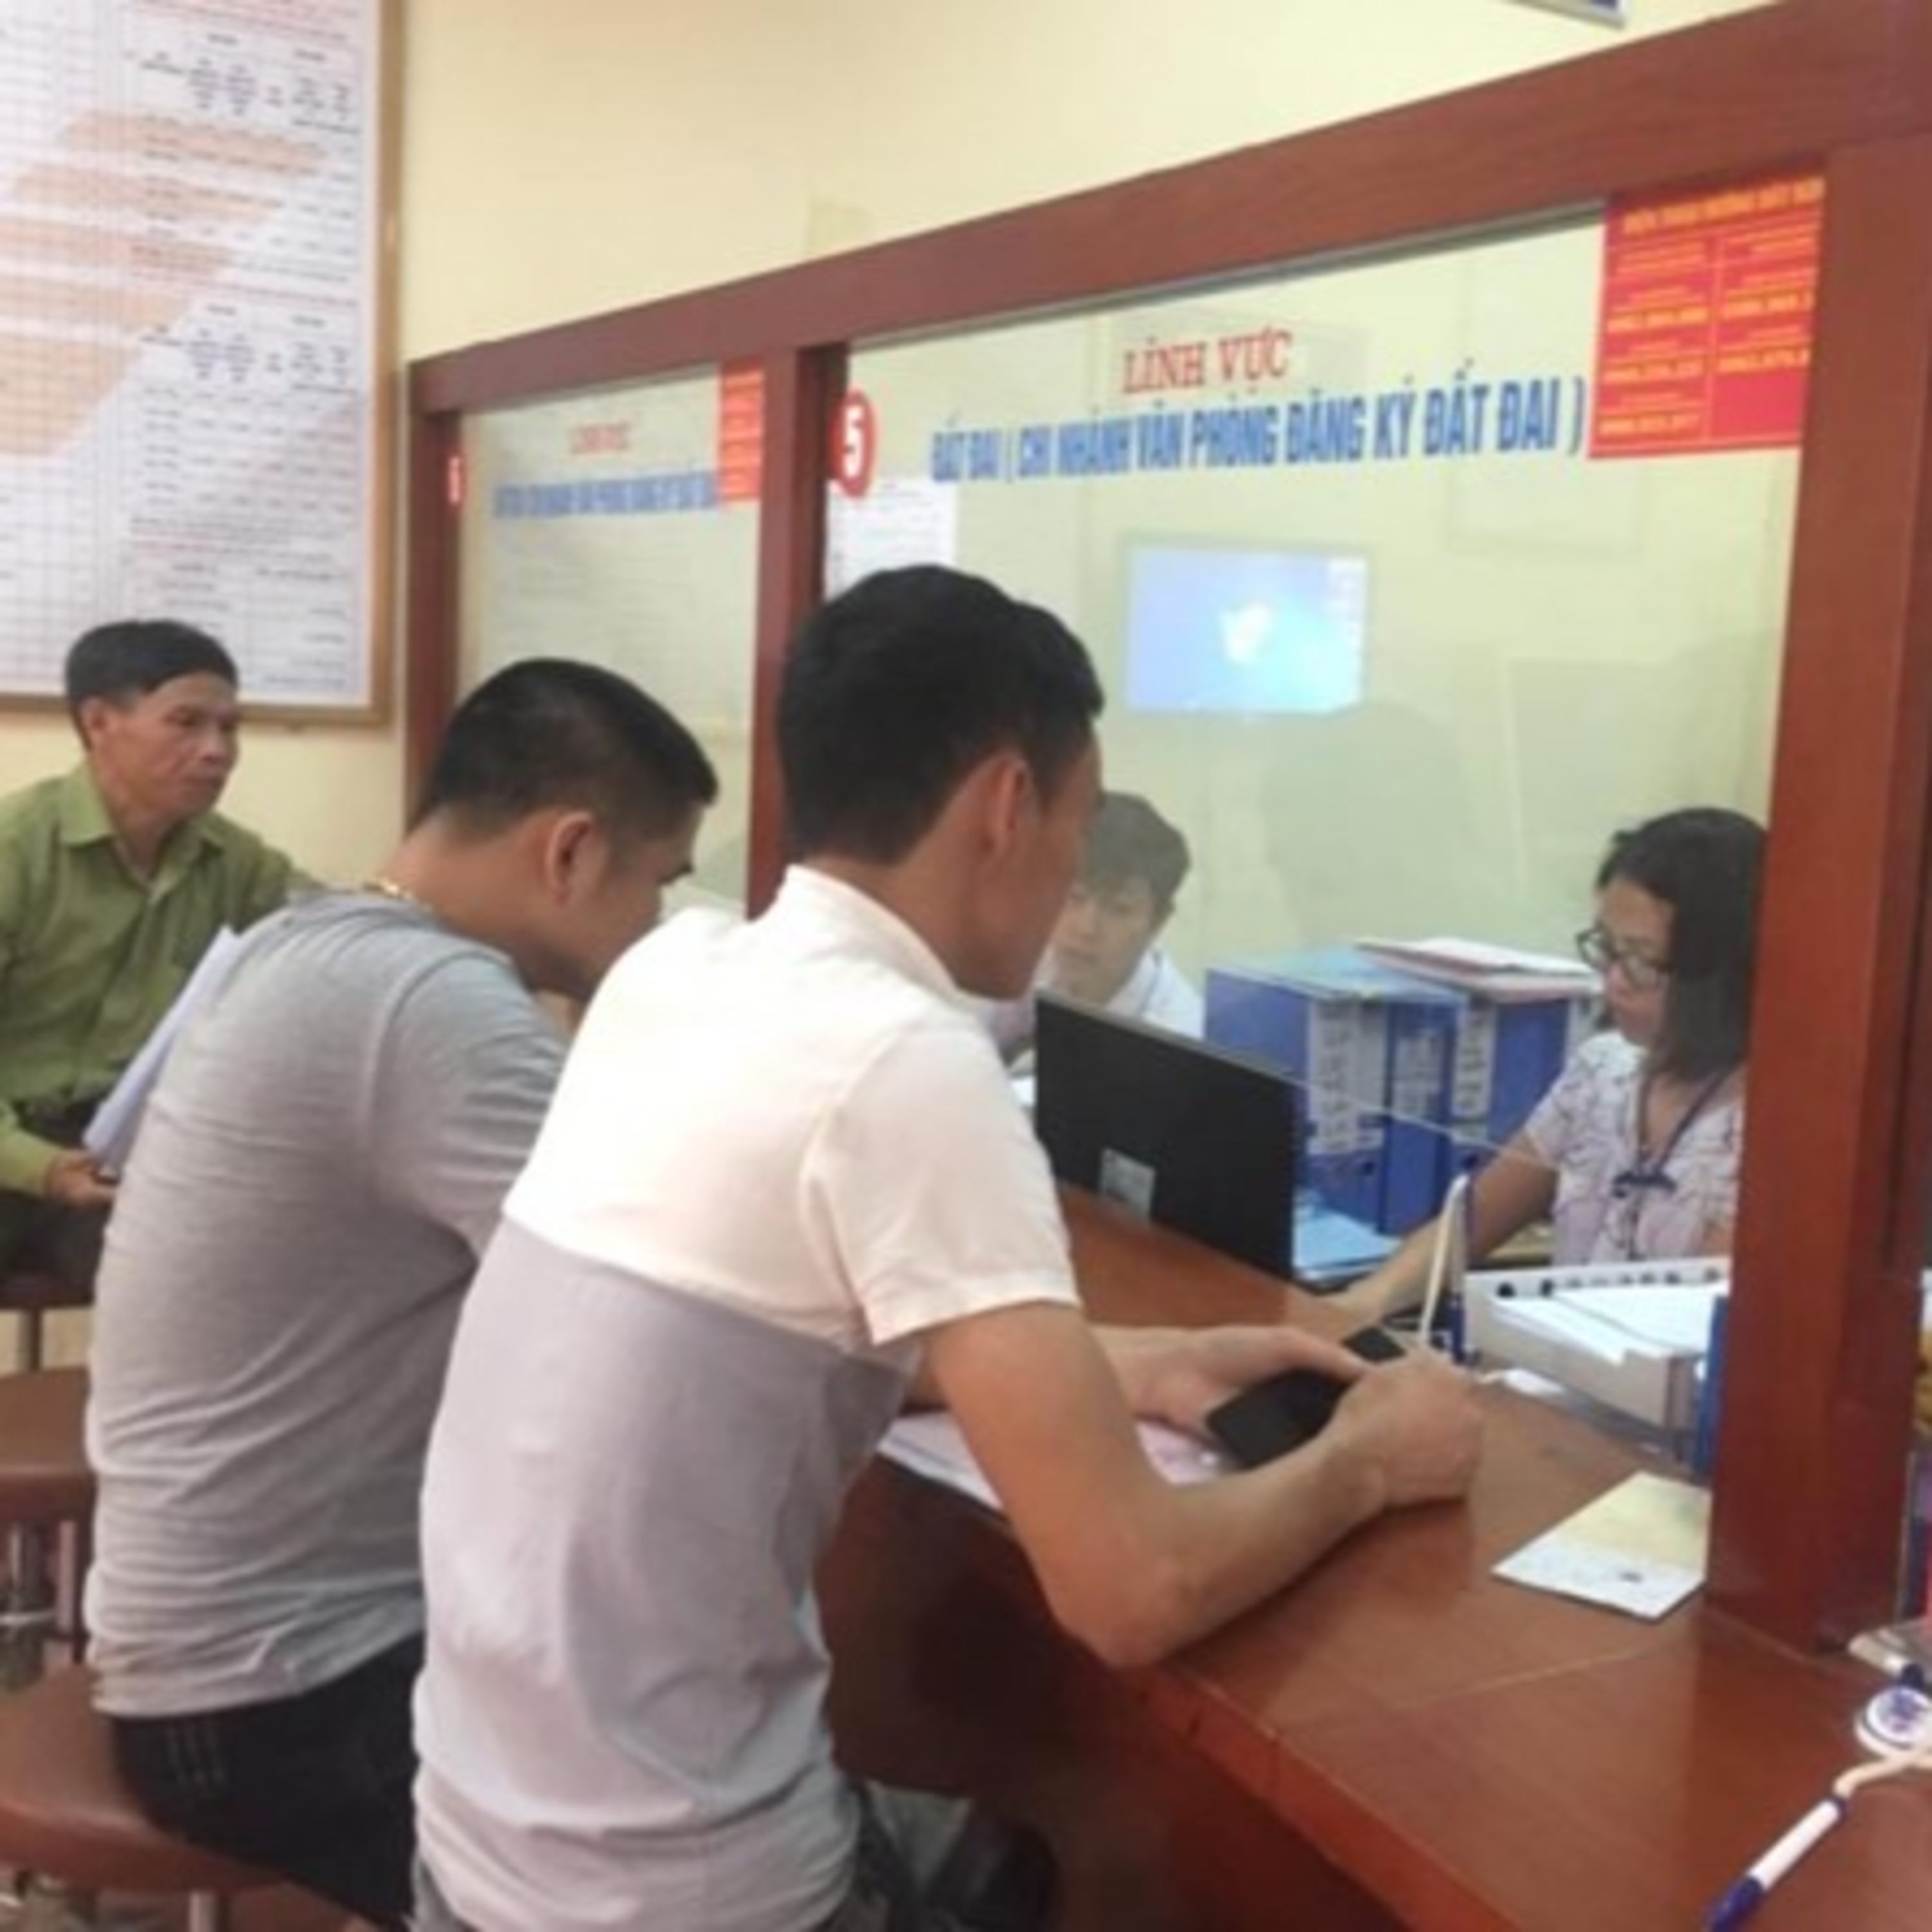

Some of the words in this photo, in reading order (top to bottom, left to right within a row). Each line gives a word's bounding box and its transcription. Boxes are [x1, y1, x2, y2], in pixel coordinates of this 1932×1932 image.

[844, 404, 864, 479] 5
[1423, 356, 1490, 455] ĐẤT
[1497, 376, 1560, 452] ĐAI
